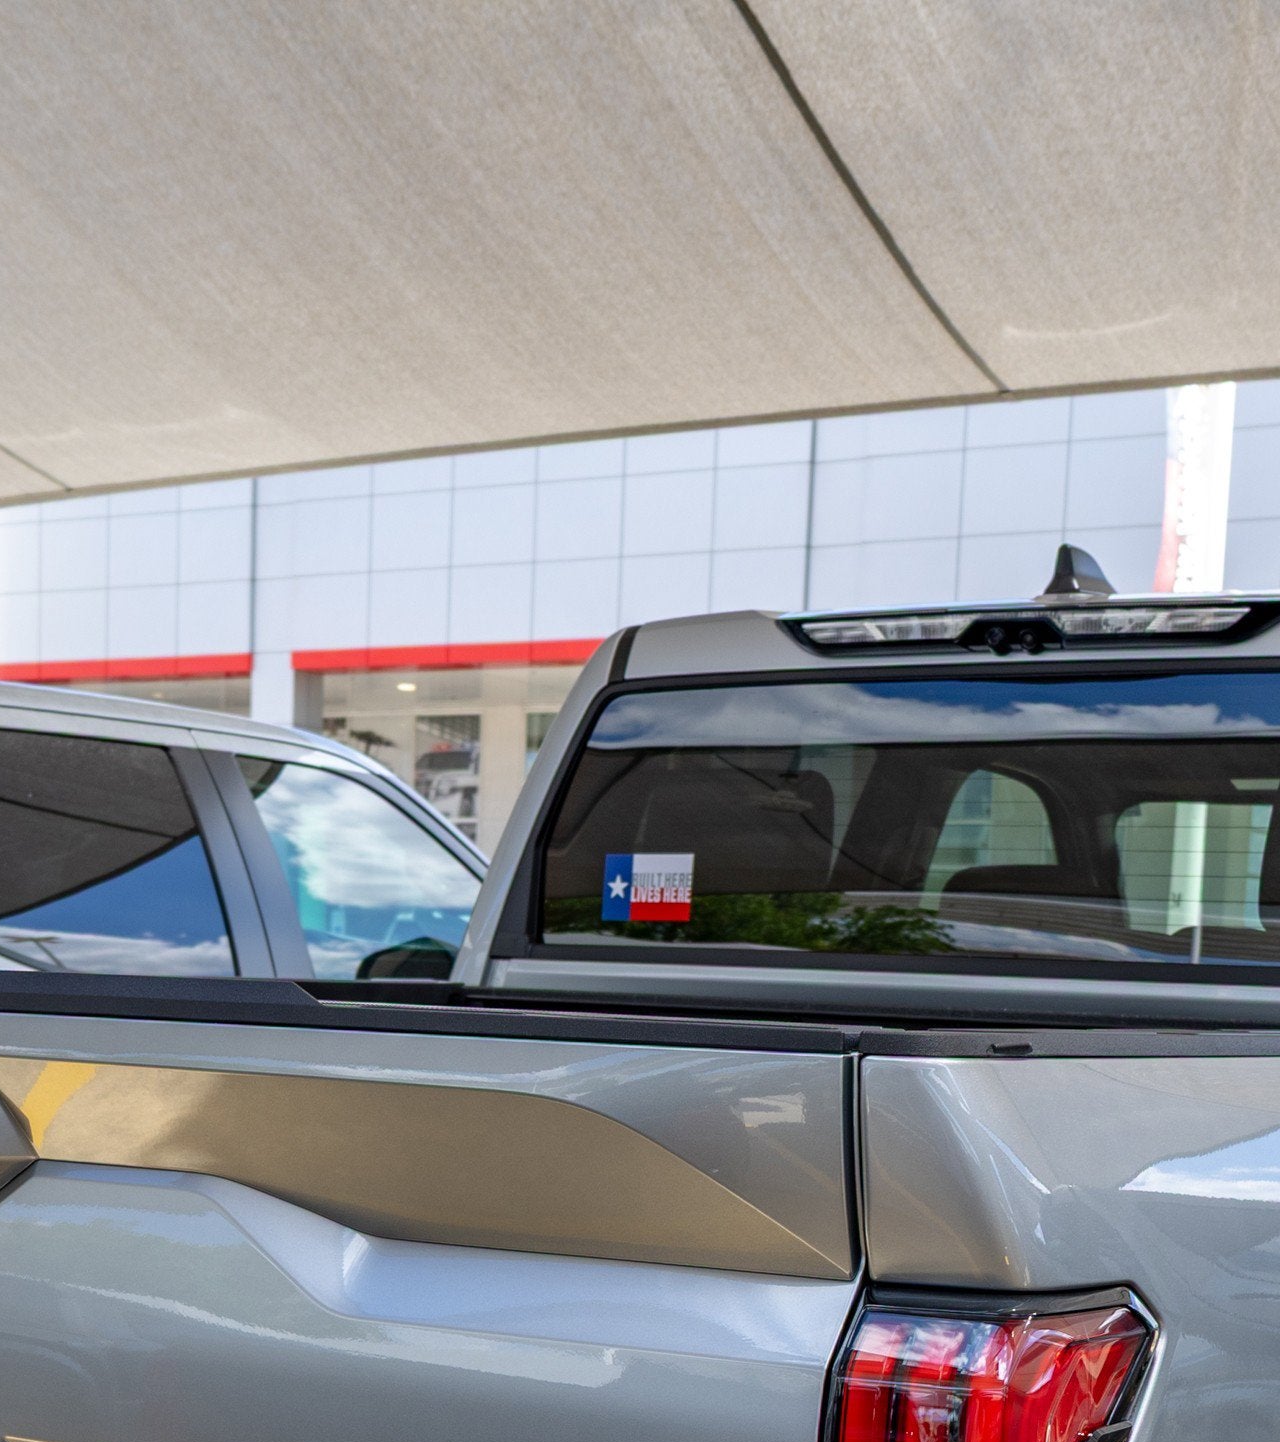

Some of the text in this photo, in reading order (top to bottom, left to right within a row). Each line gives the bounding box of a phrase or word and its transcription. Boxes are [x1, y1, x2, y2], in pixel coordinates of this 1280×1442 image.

[632, 872, 691, 888] BUILT HERE
[631, 887, 691, 903] LIVES HERE
